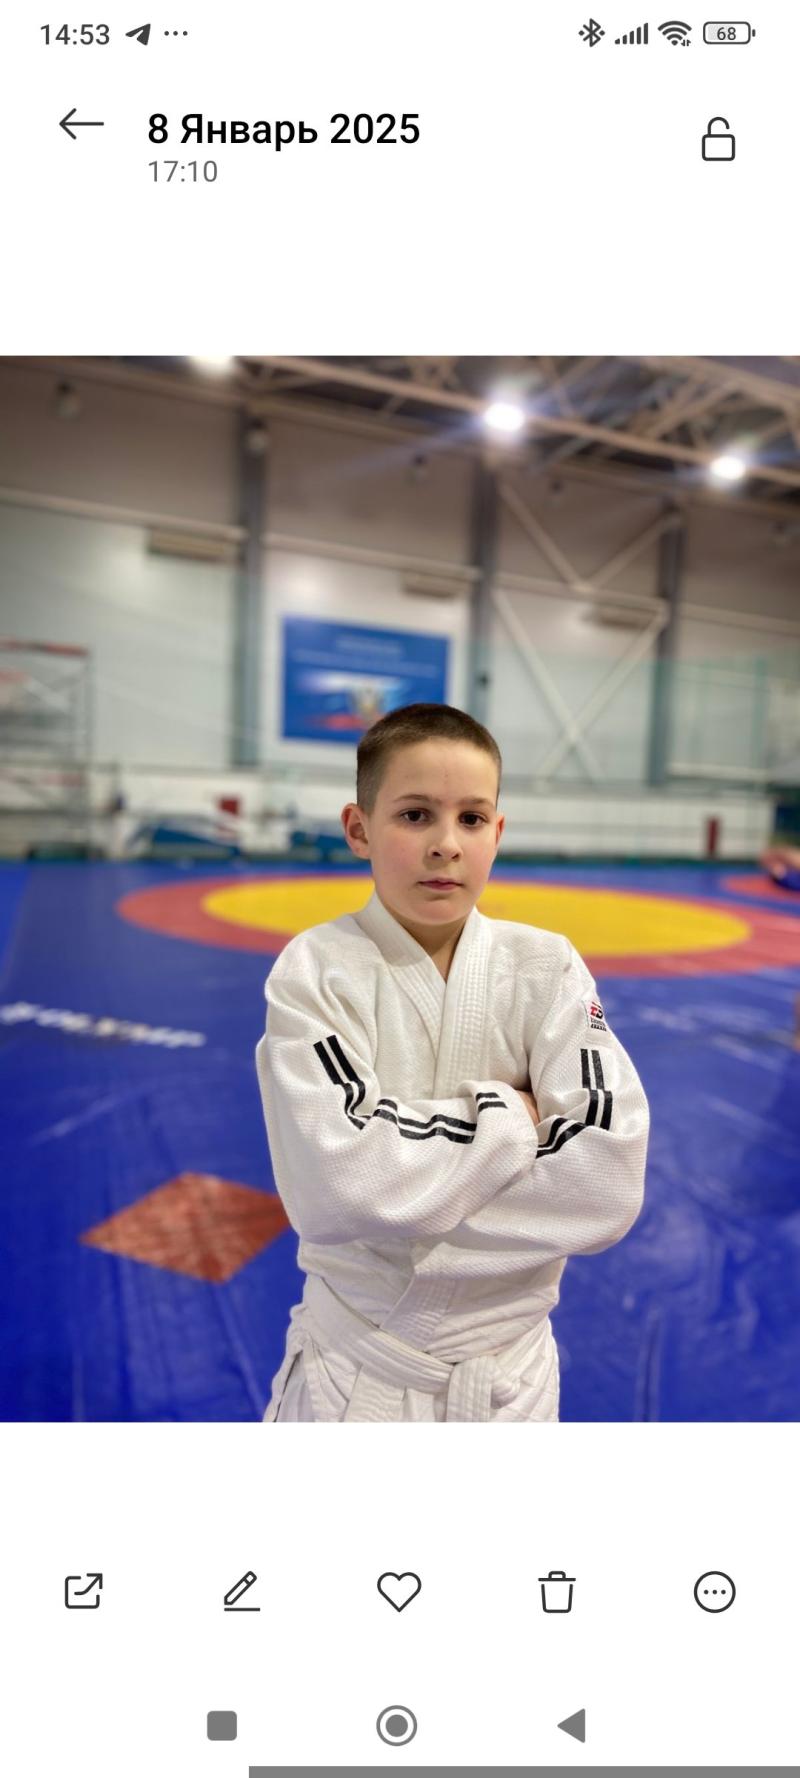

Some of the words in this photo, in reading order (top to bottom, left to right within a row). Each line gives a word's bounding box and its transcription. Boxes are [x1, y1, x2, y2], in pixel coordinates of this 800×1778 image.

[40, 24, 110, 46] 14:53
[716, 27, 737, 41] 68
[148, 113, 169, 144] 8
[180, 113, 319, 152] Январь
[329, 113, 420, 145] 2025
[148, 160, 218, 183] 17:10
